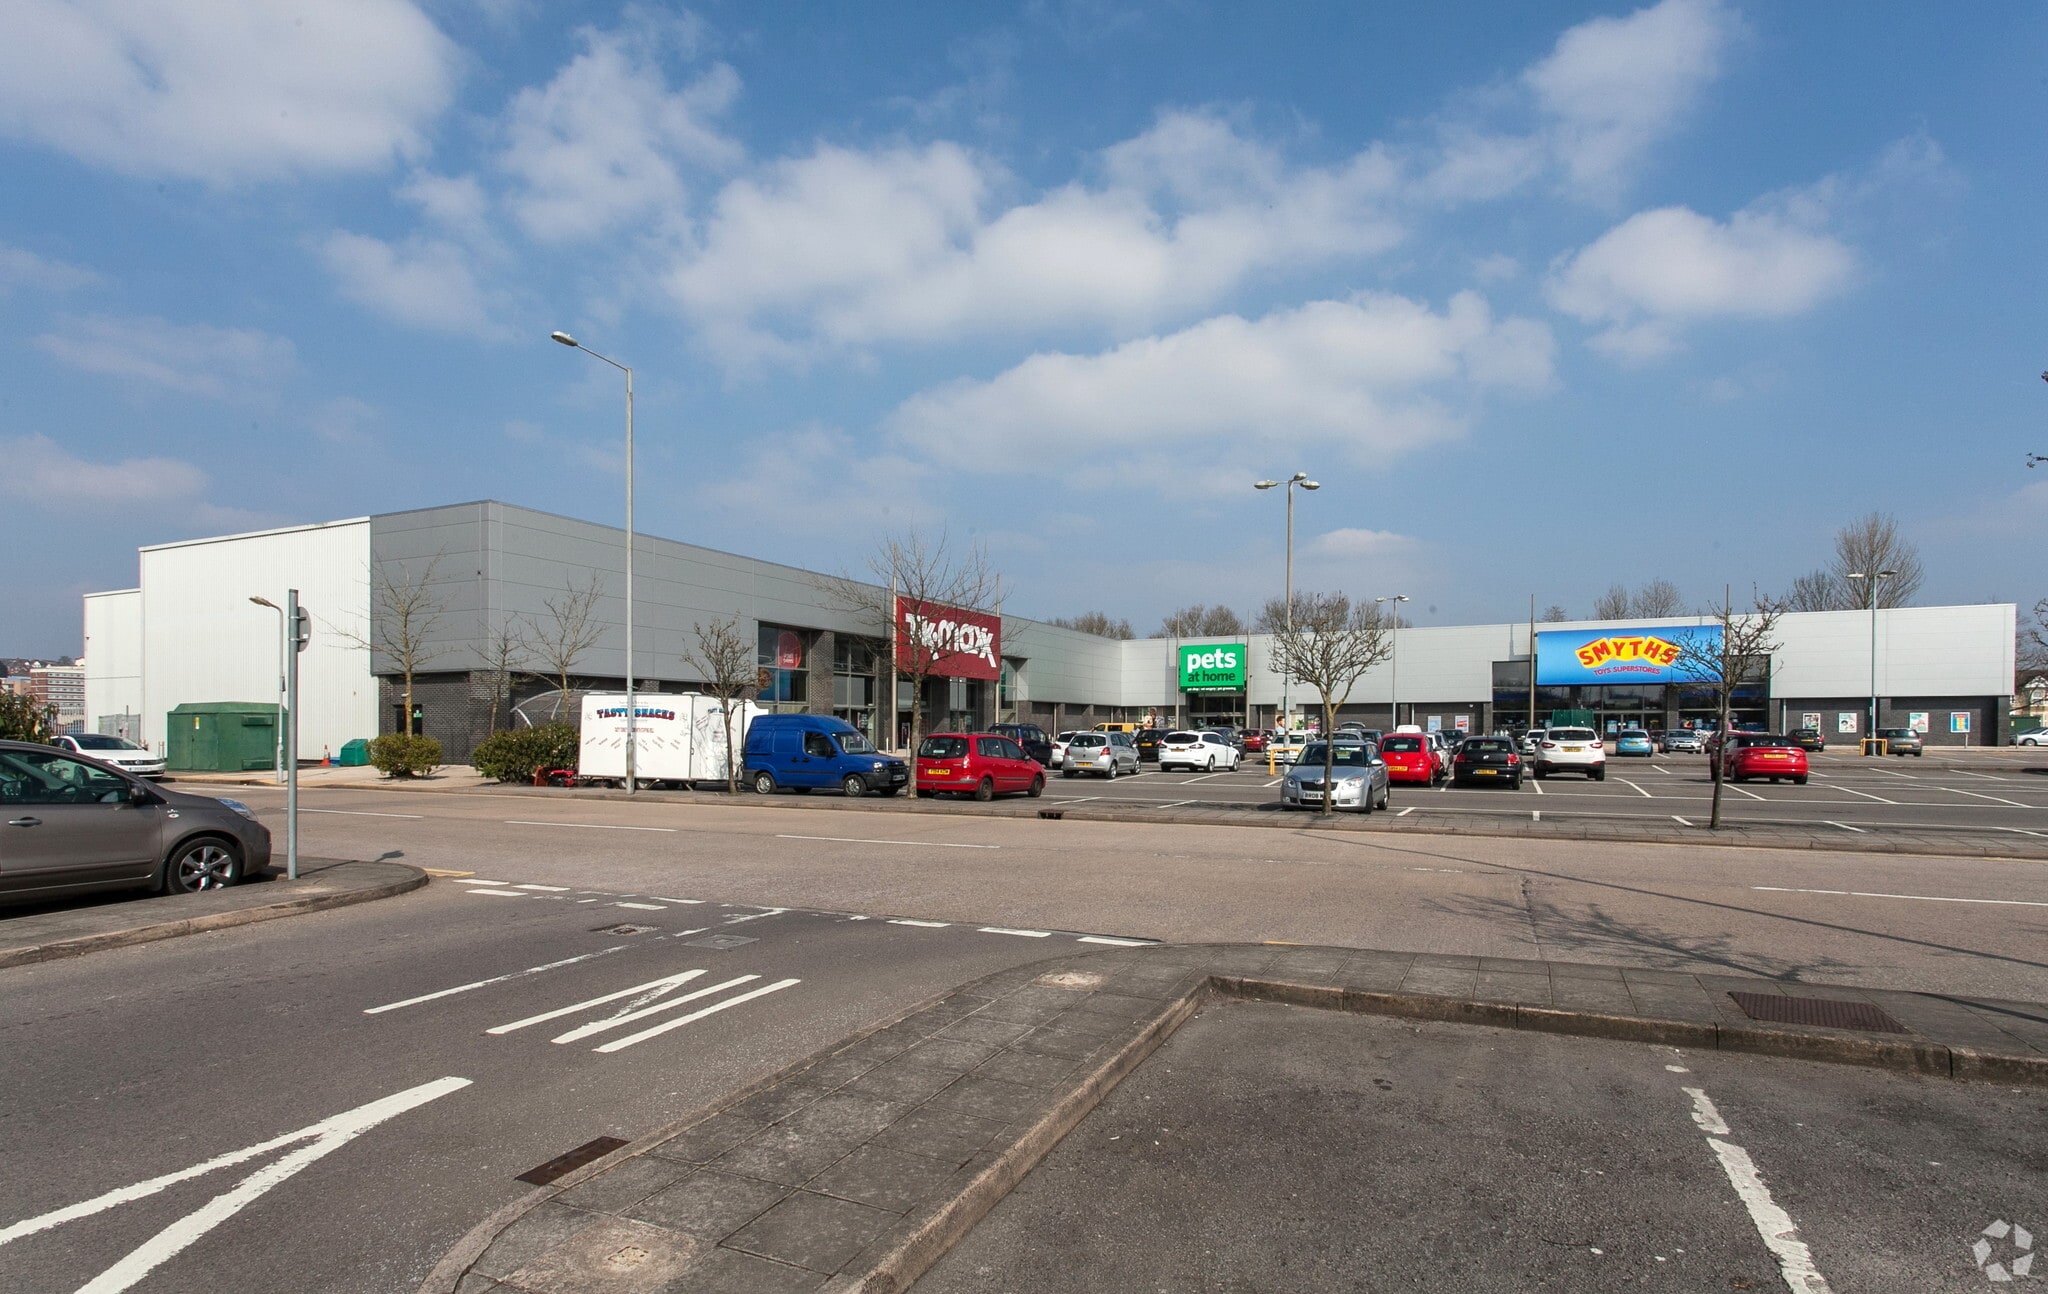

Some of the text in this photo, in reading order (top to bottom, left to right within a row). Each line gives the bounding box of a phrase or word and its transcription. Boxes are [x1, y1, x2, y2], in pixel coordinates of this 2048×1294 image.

[1579, 641, 1679, 665] SMYTHS
[1187, 648, 1237, 673] pets
[1187, 670, 1236, 682] at home
[1594, 665, 1661, 676] TOYS SUPERSTORES
[596, 708, 675, 720] TASTY SNACKS
